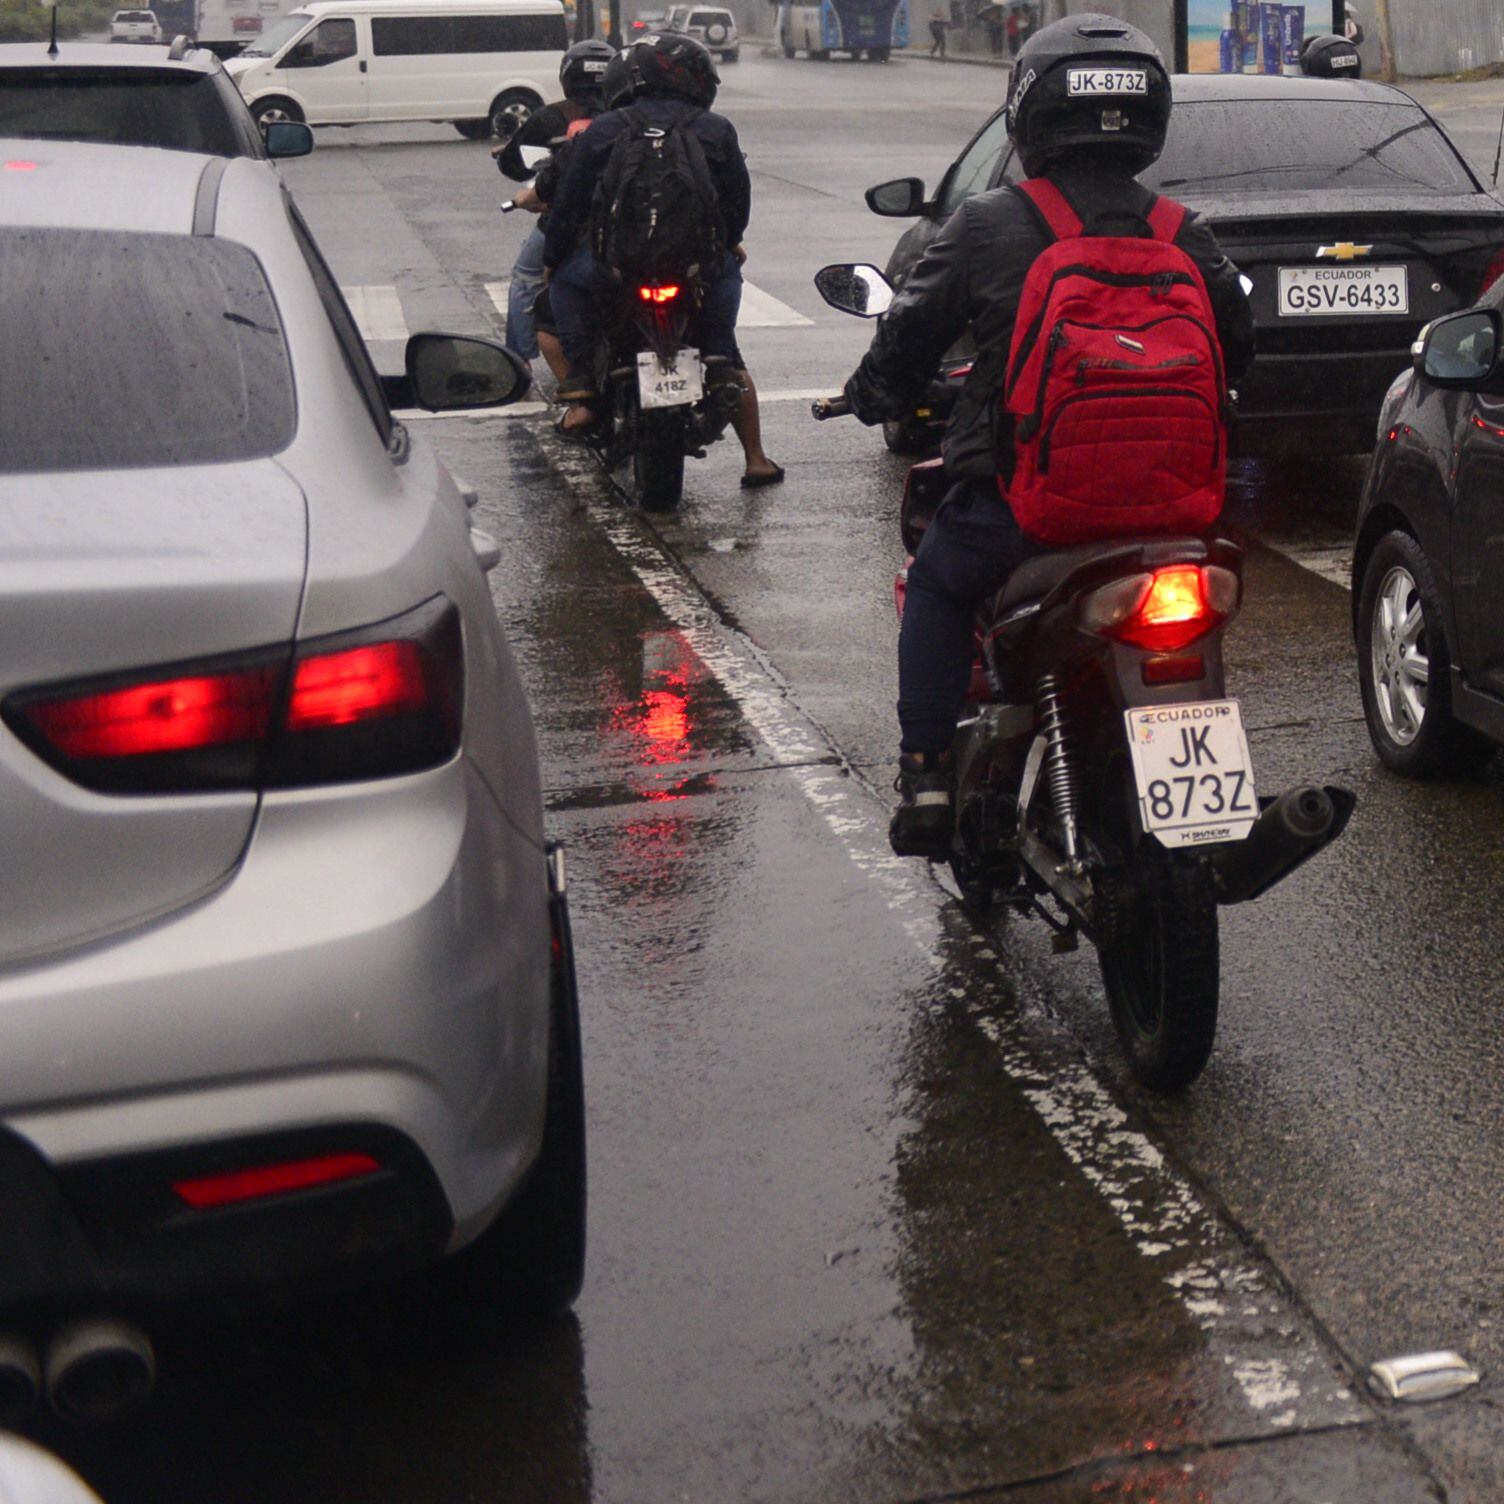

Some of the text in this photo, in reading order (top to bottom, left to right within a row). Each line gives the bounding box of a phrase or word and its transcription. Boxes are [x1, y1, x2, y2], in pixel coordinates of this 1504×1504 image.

[1072, 73, 1145, 91] JK-873Z
[1315, 270, 1372, 281] ECUADOR
[1287, 283, 1400, 309] GSV-6433
[1145, 706, 1229, 725] ECUADOR
[1169, 725, 1218, 768] JK
[1148, 770, 1252, 820] 873Z
